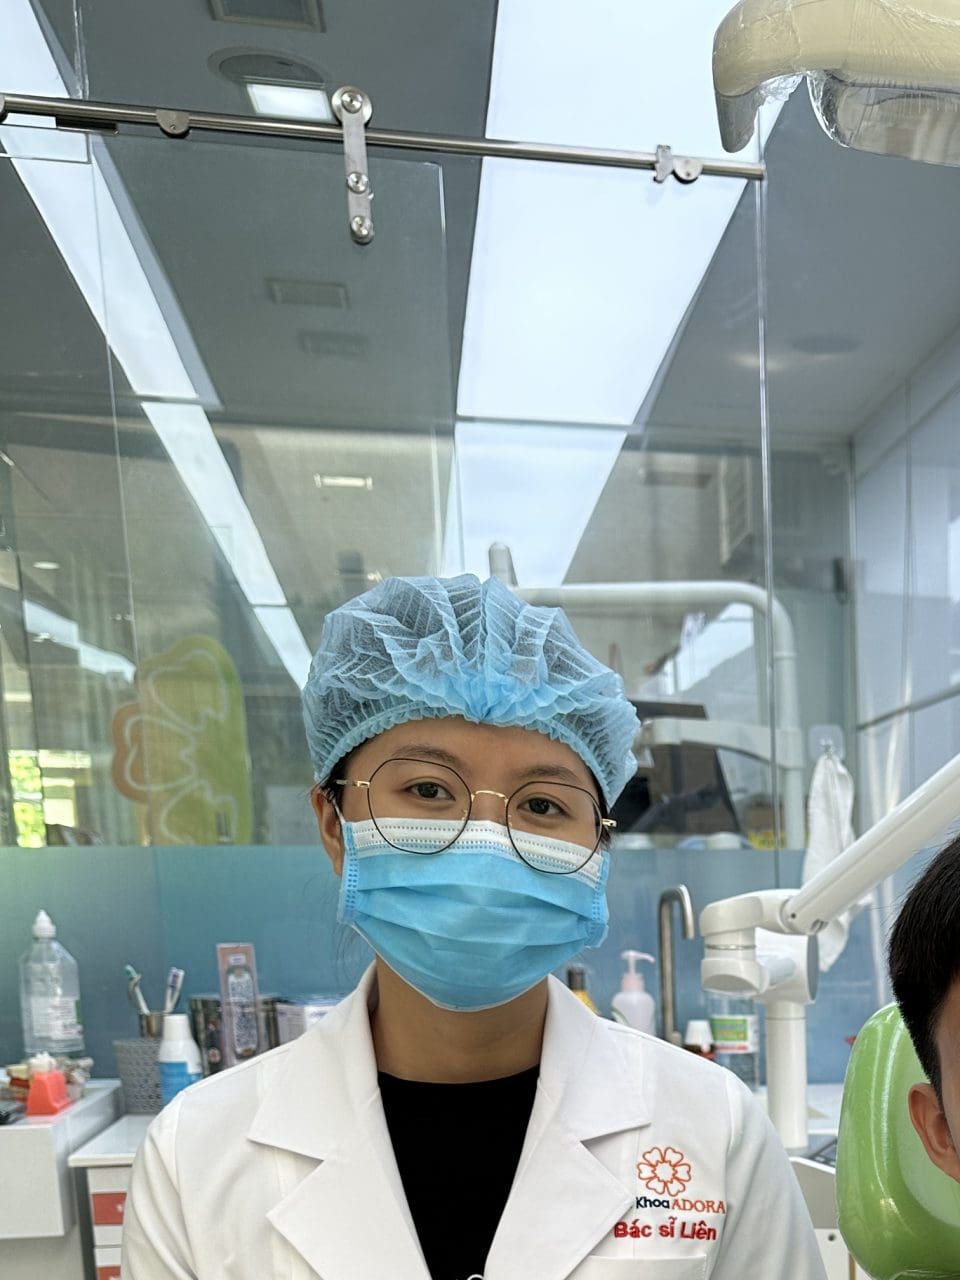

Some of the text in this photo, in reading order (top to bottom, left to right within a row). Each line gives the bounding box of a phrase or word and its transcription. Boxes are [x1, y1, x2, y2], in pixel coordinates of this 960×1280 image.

[636, 1196, 726, 1215] Khoa ADORA
[614, 1215, 717, 1241] Bác sĩ Liên
